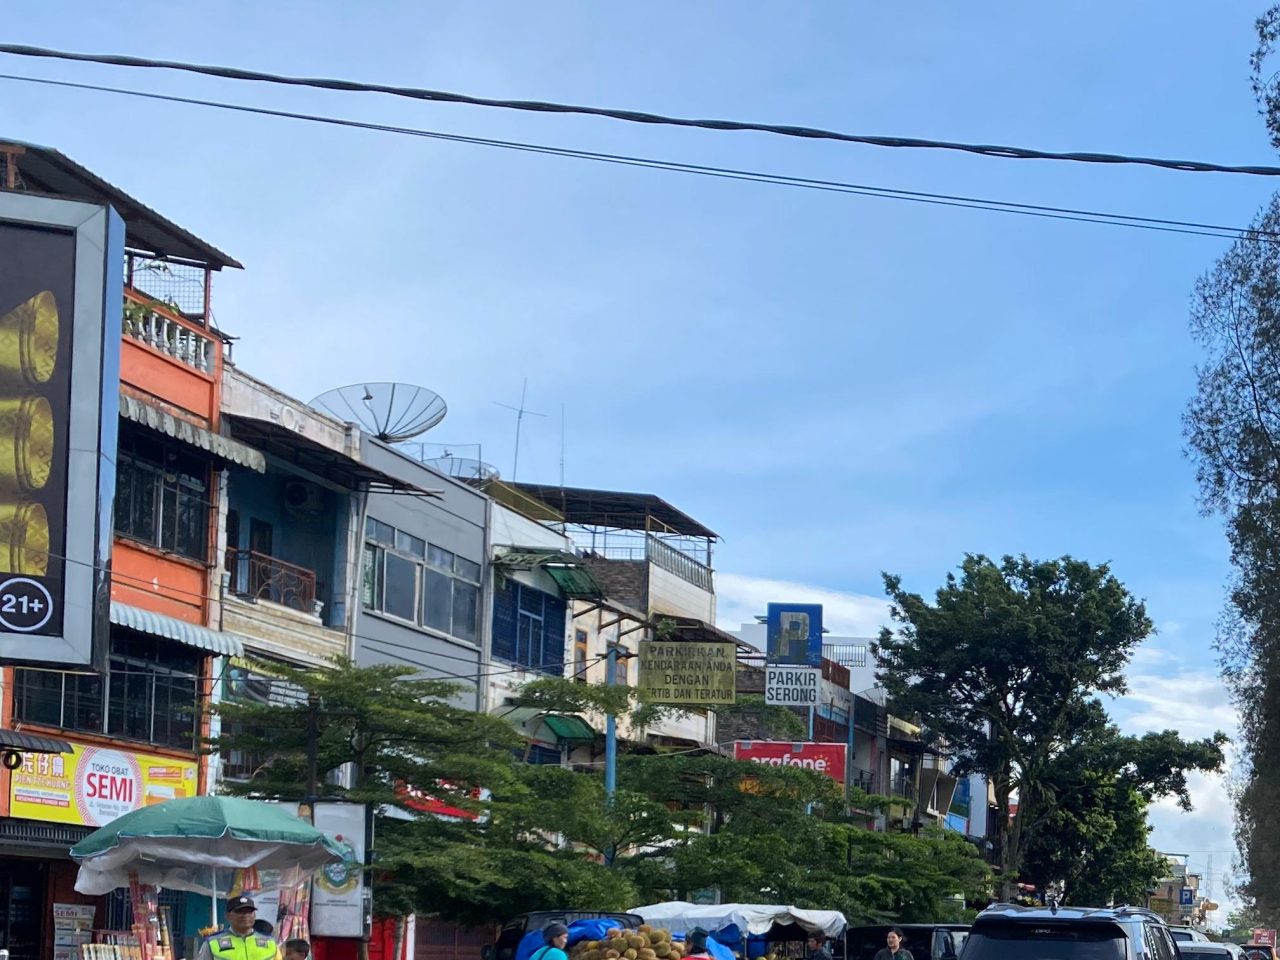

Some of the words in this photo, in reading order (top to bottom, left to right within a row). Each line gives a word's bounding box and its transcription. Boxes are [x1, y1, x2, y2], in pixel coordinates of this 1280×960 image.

[2, 593, 44, 614] 21+
[780, 611, 810, 656] P
[649, 646, 725, 657] PARKIRKAN
[641, 660, 701, 671] KENDARAAN
[706, 661, 733, 672] ANDA
[664, 674, 709, 686] DENGAN
[768, 671, 817, 687] PARKIR
[673, 688, 692, 699] DAN
[695, 688, 733, 700] TERATUR
[767, 686, 817, 703] SERONG
[91, 762, 110, 774] TOKO
[110, 765, 129, 777] OBAT
[86, 772, 133, 803] SEMI
